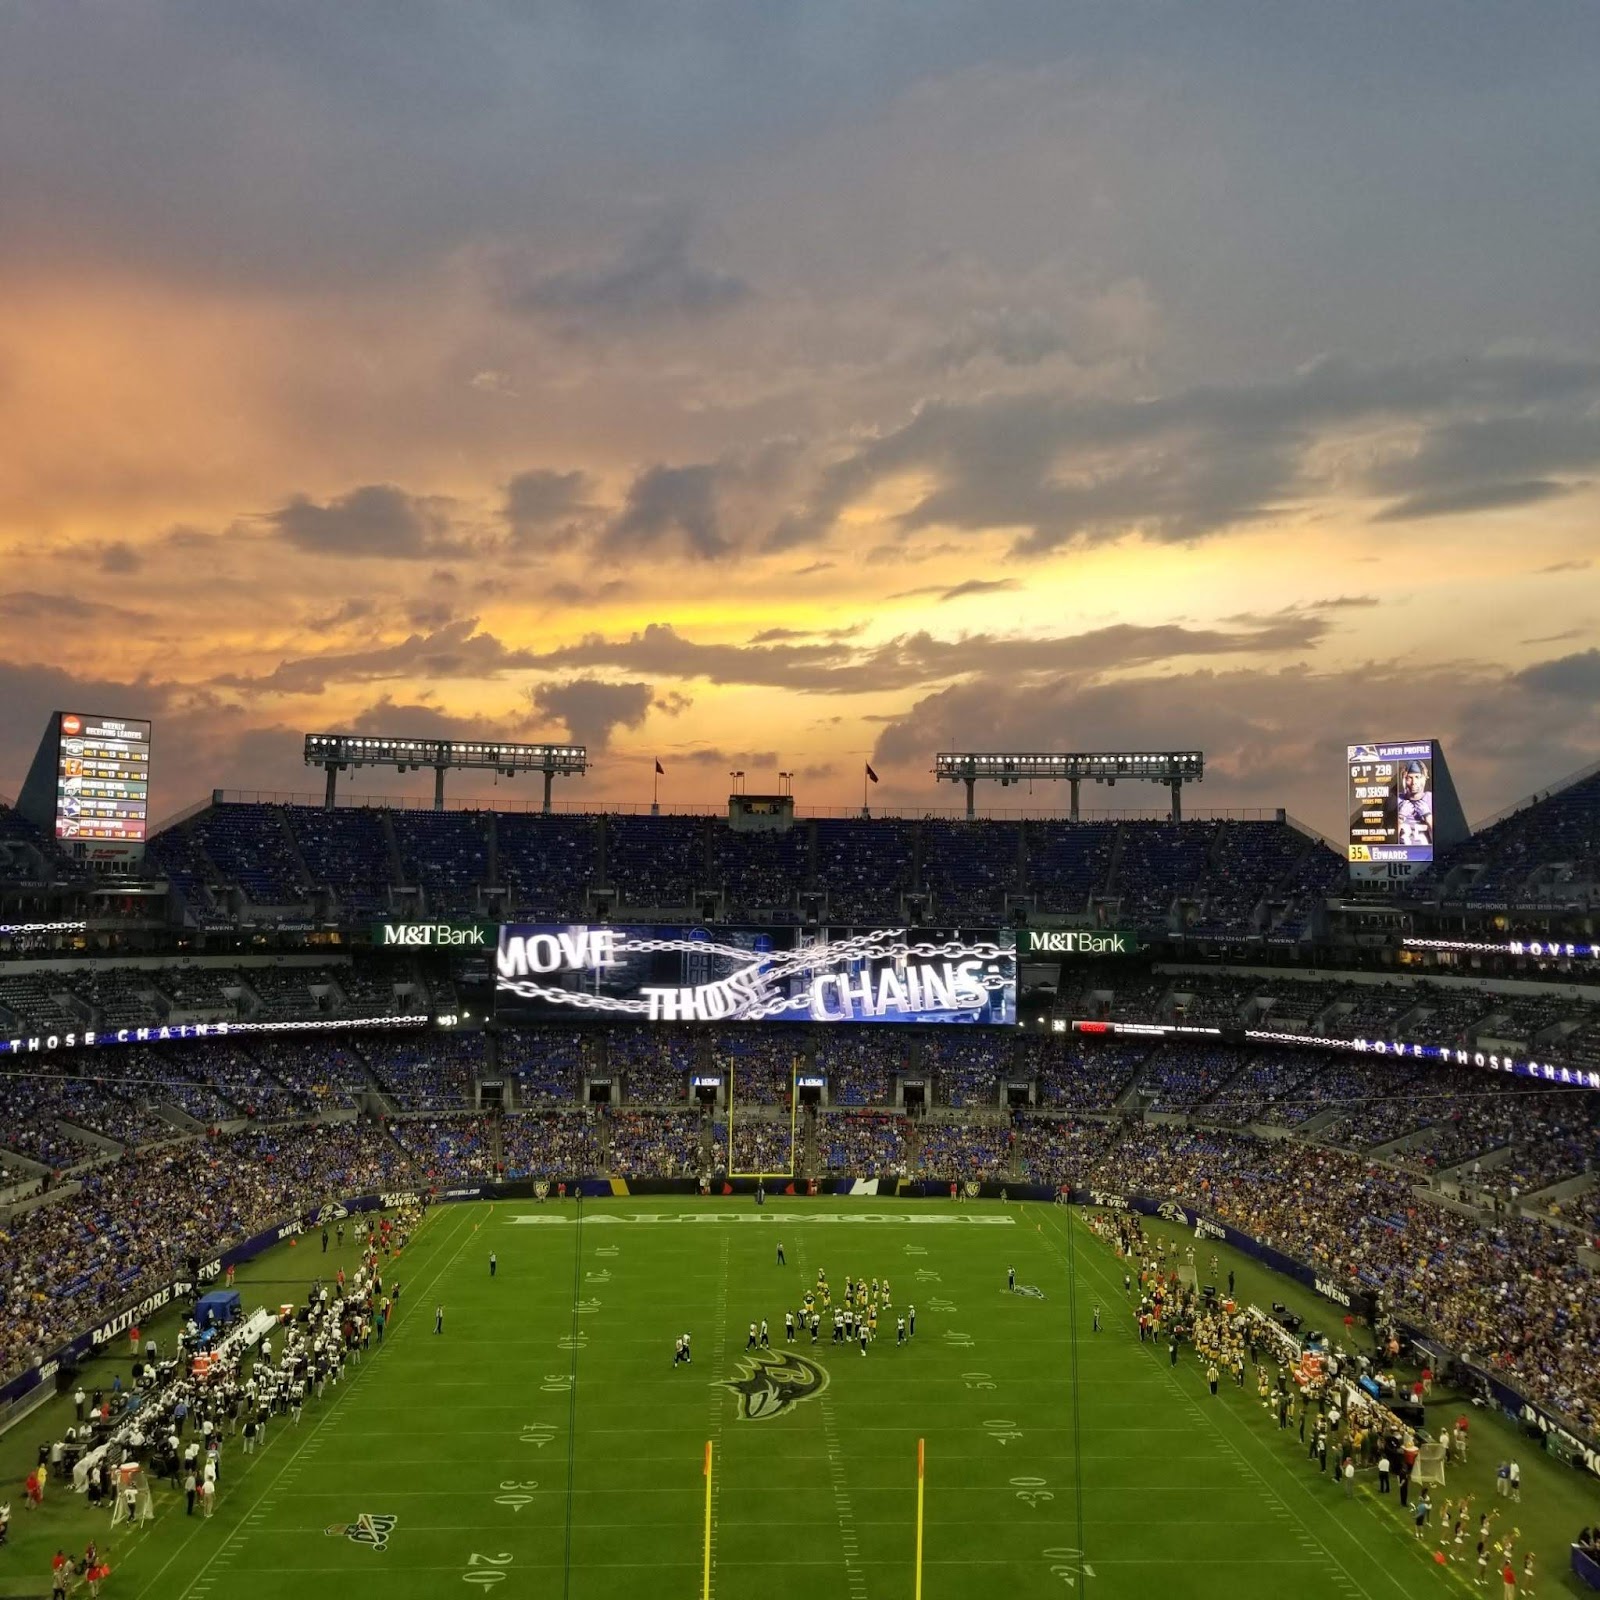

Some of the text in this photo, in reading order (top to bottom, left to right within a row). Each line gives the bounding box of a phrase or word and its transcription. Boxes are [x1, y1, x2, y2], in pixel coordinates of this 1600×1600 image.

[1380, 745, 1430, 756] PLAYER PROFILE
[1375, 764, 1392, 776] 238
[1367, 786, 1389, 797] SEASON
[1351, 847, 1363, 859] 35
[1372, 850, 1408, 860] EDWARDS
[1387, 862, 1412, 879] Lite
[383, 925, 485, 944] M&T Bank
[1029, 931, 1126, 952] M&T Bank
[497, 930, 627, 978] MOVE
[1510, 941, 1576, 957] MOVE
[810, 960, 990, 1021] CHAINS
[10, 1022, 230, 1053] THOSE CHAINS
[1354, 1038, 1600, 1088] MOVE THOSE CHAIN
[380, 1192, 401, 1202] PLAY
[385, 1195, 420, 1208] RAVEN
[1095, 1197, 1129, 1208] RVEN
[504, 1213, 1016, 1224] BALTIMORE
[494, 1480, 539, 1504] 30
[1009, 1477, 1055, 1500] 30
[462, 1553, 514, 1583] 20
[1043, 1548, 1097, 1577] 20
